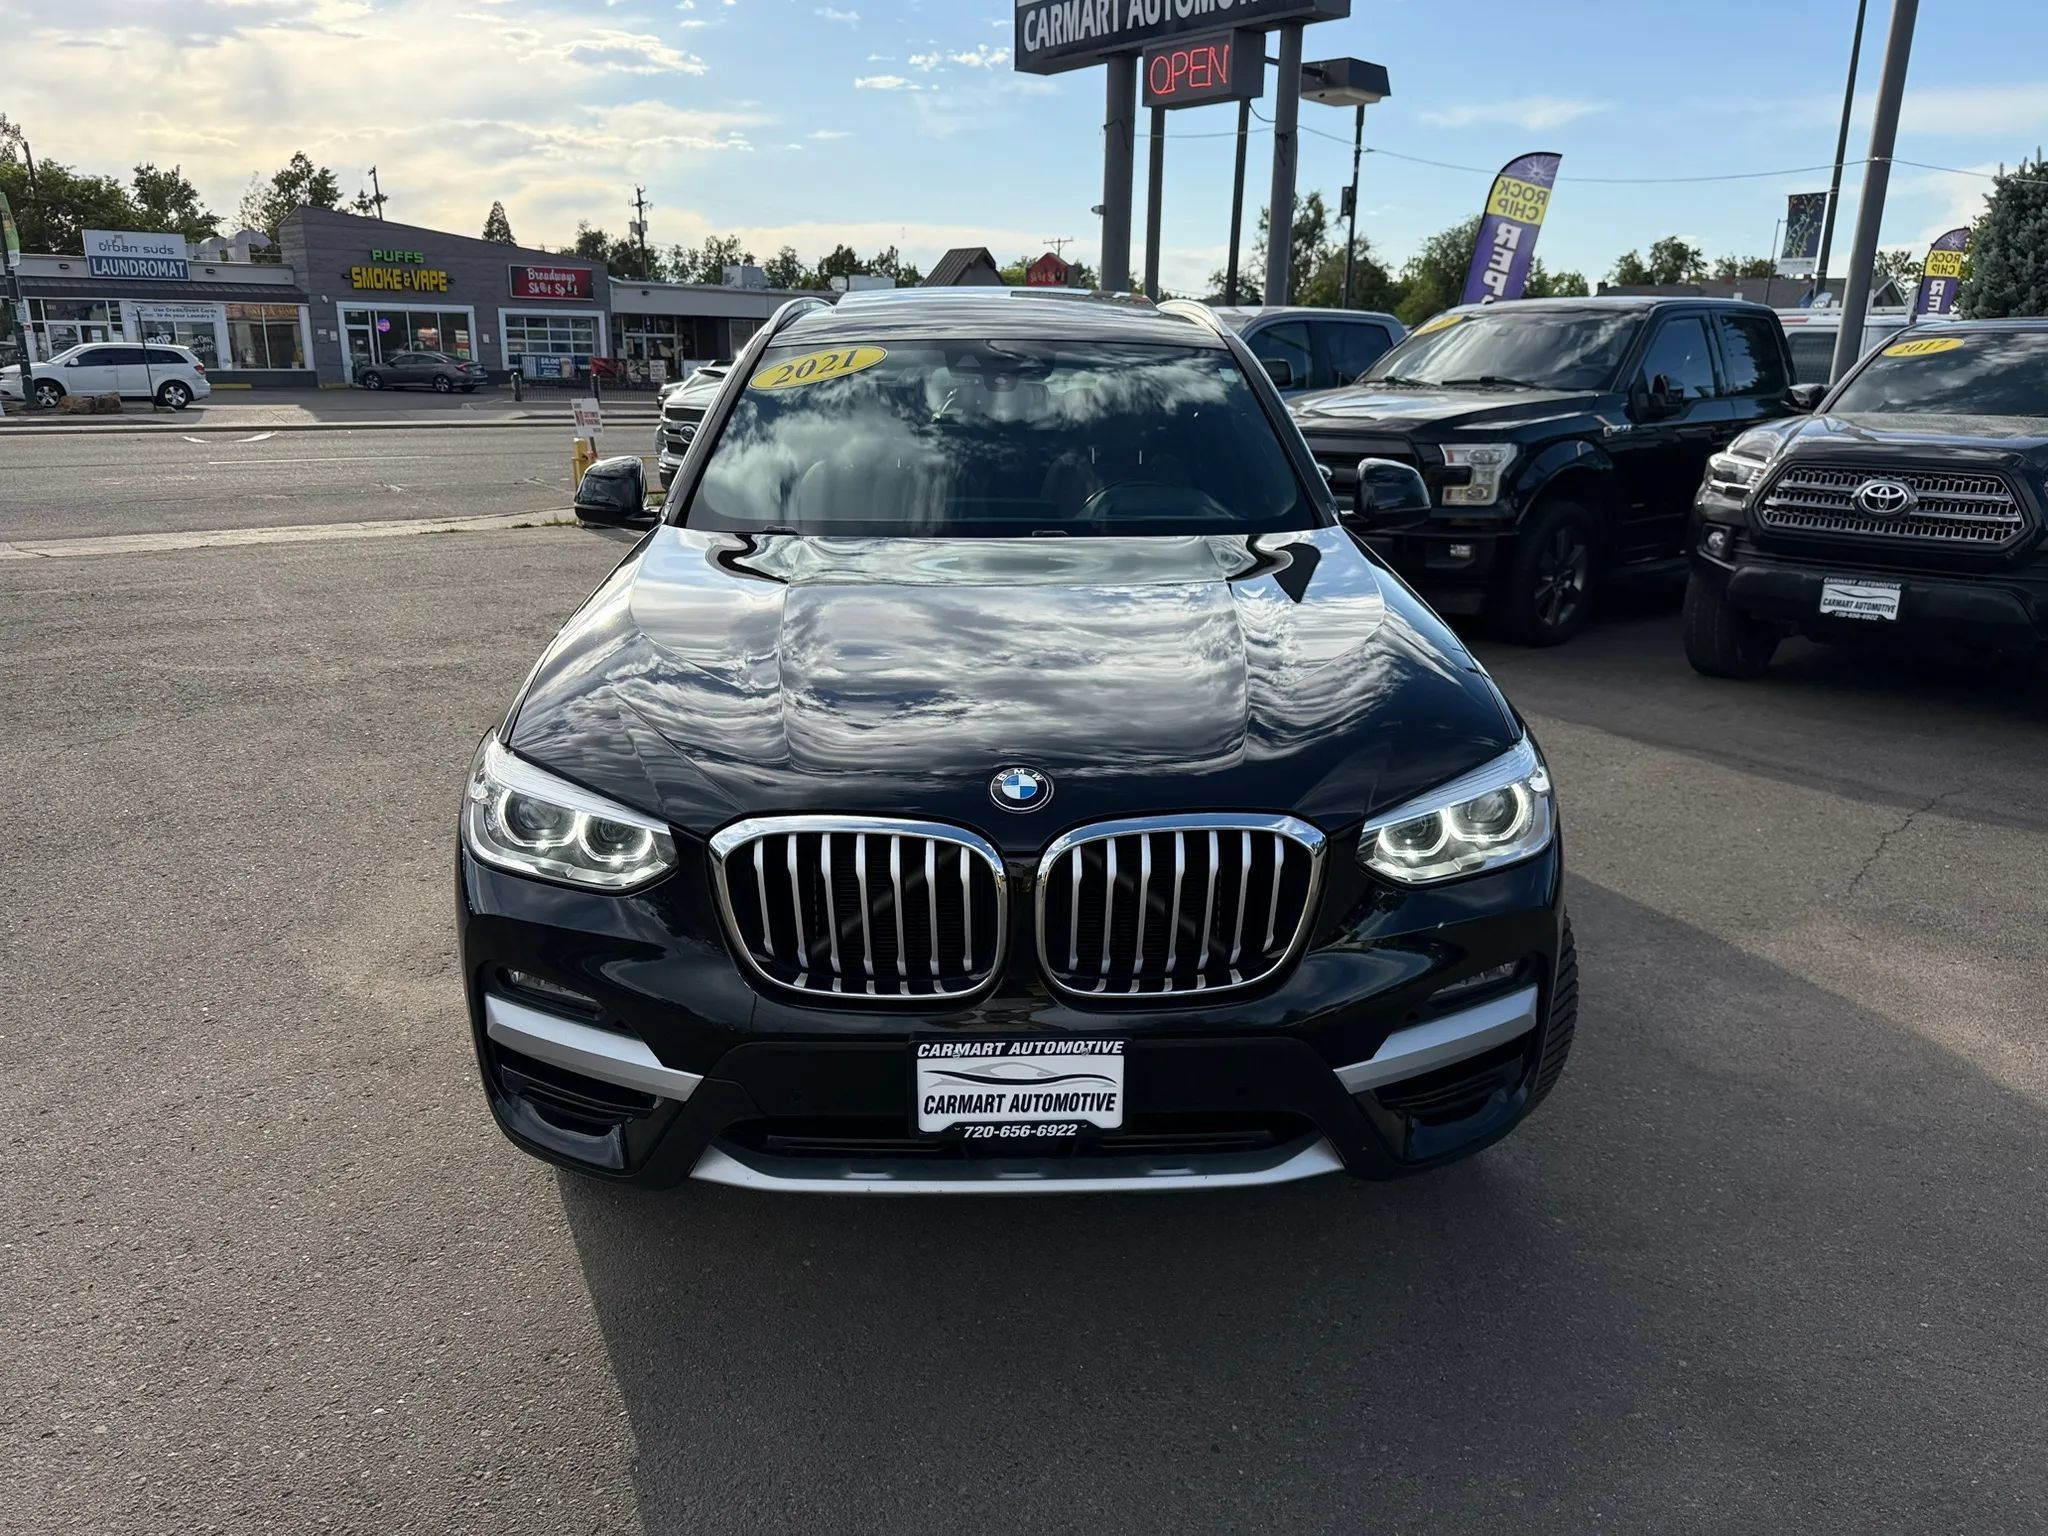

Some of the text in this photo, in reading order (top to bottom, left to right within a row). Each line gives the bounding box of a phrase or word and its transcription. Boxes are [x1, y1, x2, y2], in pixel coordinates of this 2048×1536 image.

[1149, 44, 1230, 95] OPEN
[143, 244, 175, 255] suds
[371, 248, 424, 264] PUFFS
[92, 258, 185, 278] LAUNDROMAT
[351, 266, 448, 292] SMOKE & VAPE
[1893, 340, 1953, 355] 2017
[771, 349, 859, 386] 2021
[1824, 577, 1902, 589] CARMART AUTOMOTIVE
[1823, 598, 1897, 614] CARMART AUTOMOTIVE
[997, 768, 1044, 781] BMW
[917, 1040, 1125, 1058] CARMART AUTOMOTIVE
[923, 1092, 1117, 1116] CARMART AUTOMOTIVE
[963, 1123, 1078, 1139] 720-656-6922
